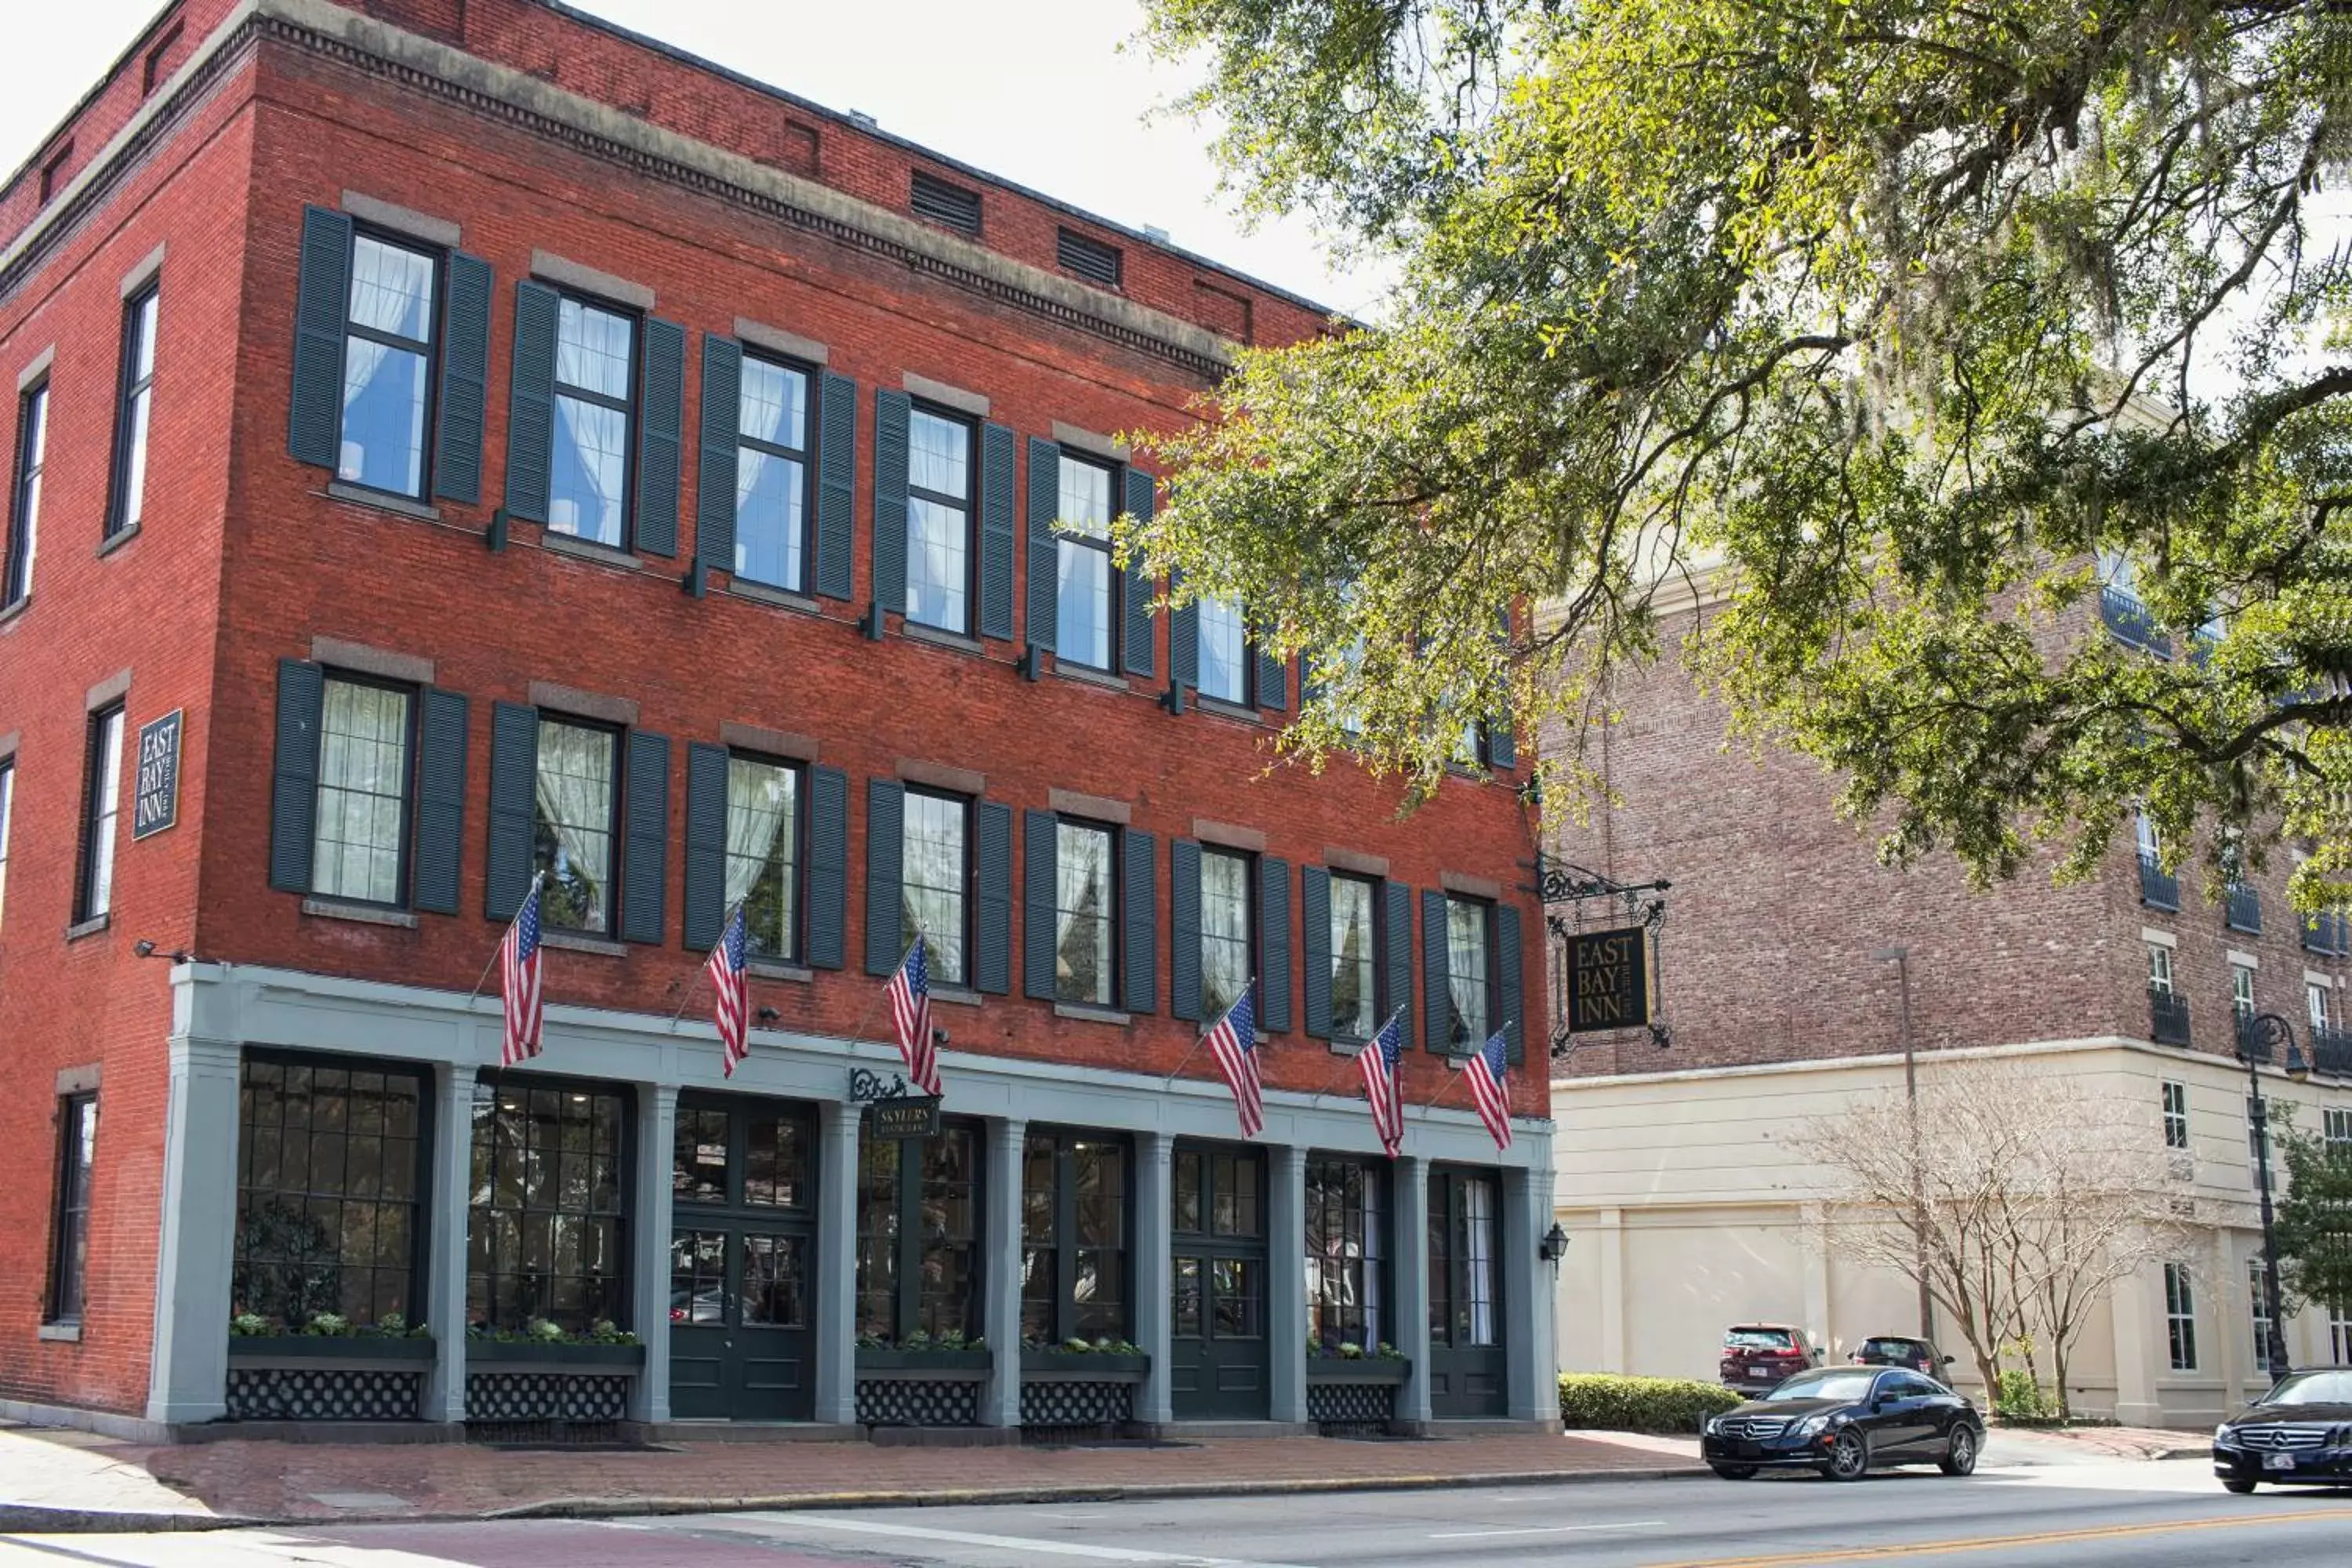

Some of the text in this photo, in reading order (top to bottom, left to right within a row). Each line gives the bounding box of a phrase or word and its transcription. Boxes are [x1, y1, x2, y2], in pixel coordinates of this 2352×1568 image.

[143, 723, 176, 764] EAST
[140, 758, 165, 796] BAY
[139, 790, 163, 826] INN
[1577, 937, 1633, 968] EAST
[1578, 966, 1620, 996] BAY
[1578, 994, 1622, 1024] INN
